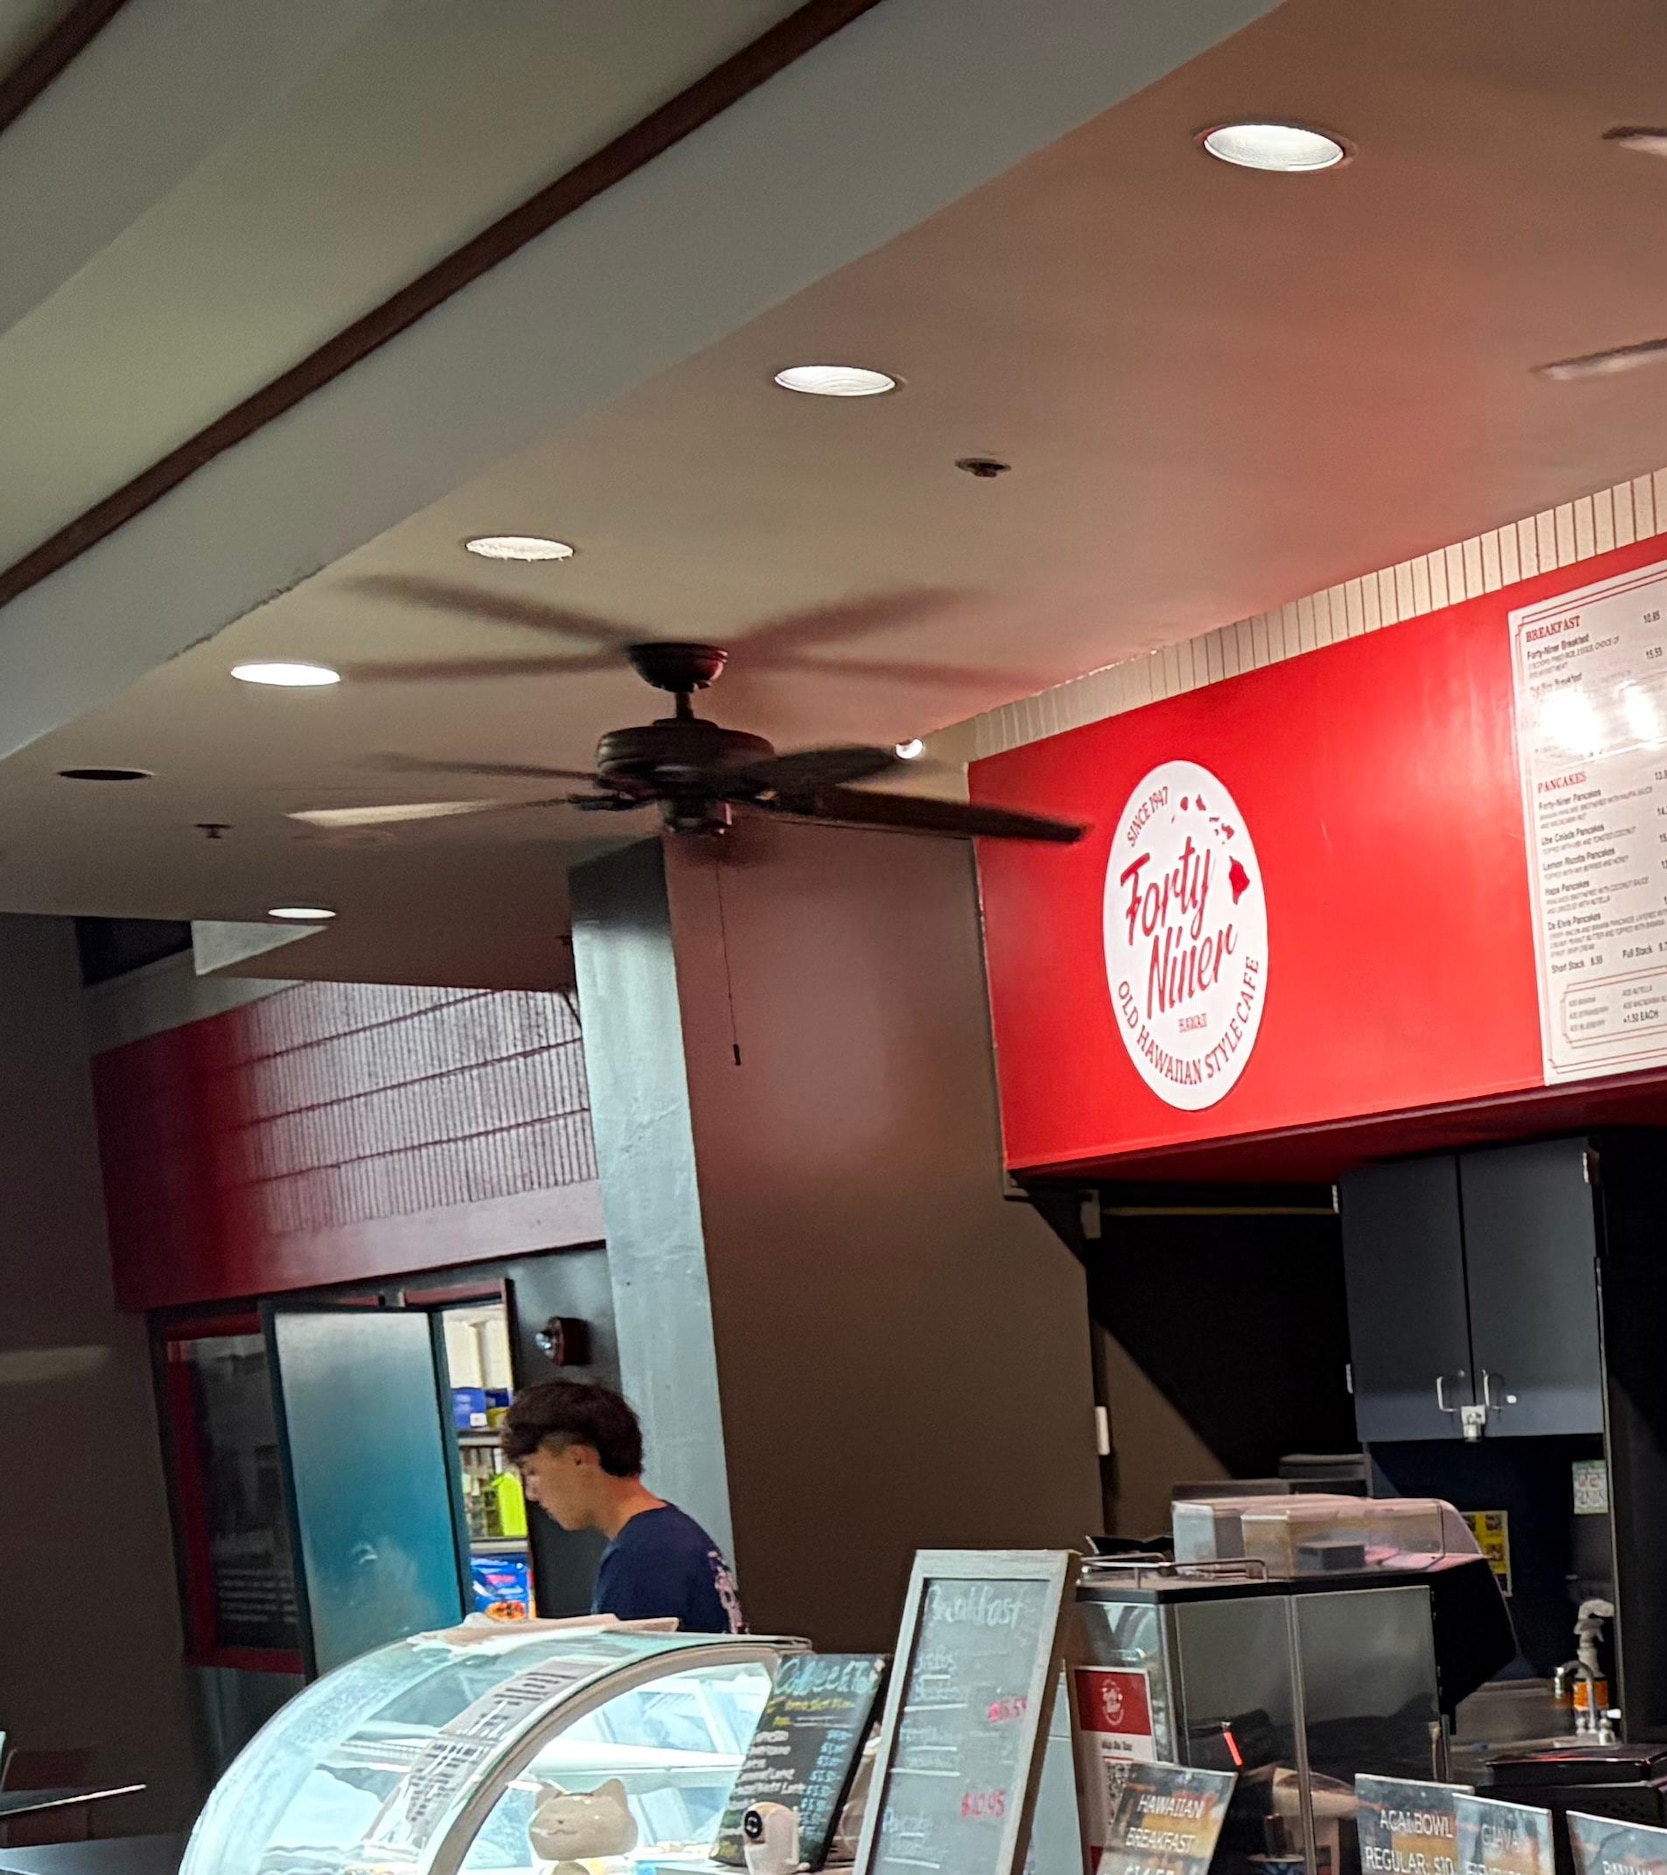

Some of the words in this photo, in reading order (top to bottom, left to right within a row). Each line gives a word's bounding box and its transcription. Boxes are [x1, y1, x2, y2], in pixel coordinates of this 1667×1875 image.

[1526, 616, 1580, 642] BREAKFAST
[1538, 772, 1587, 794] PANCAKES
[1127, 802, 1151, 847] SINCE
[1148, 786, 1169, 812] 1947
[1120, 836, 1215, 946] Forty
[1147, 923, 1238, 1020] Niner
[1118, 980, 1138, 1030] OLD
[1137, 1025, 1202, 1086] HAWAIIAN
[1206, 1020, 1242, 1078] STYLE
[1238, 956, 1259, 1024] CAFE
[1137, 1793, 1205, 1820] HAWAIIAN
[1414, 1812, 1454, 1838] BOWL
[1126, 1827, 1195, 1854] BREAKFAST
